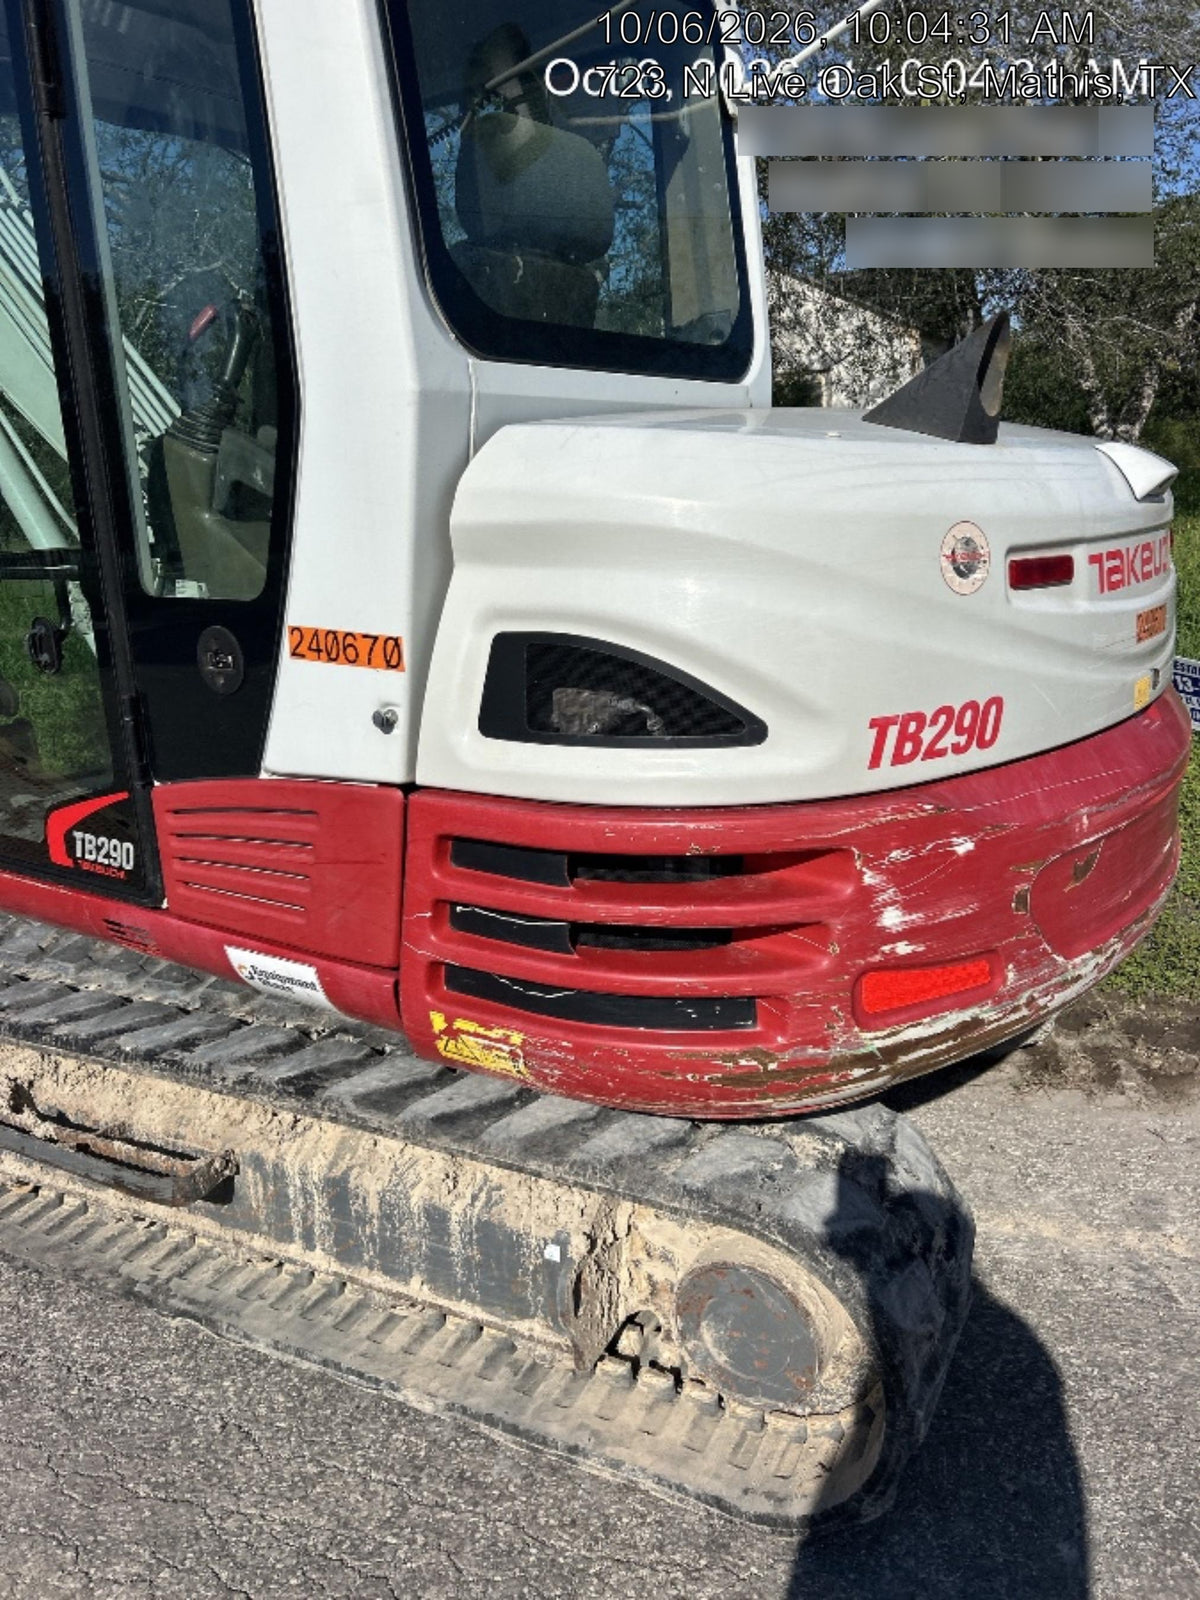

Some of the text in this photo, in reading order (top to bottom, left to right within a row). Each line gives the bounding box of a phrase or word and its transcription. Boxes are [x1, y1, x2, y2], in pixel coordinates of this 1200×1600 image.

[290, 627, 402, 669] 240670
[1174, 660, 1200, 676] ESTA
[868, 696, 1005, 770] TB290
[72, 830, 134, 870] TB290
